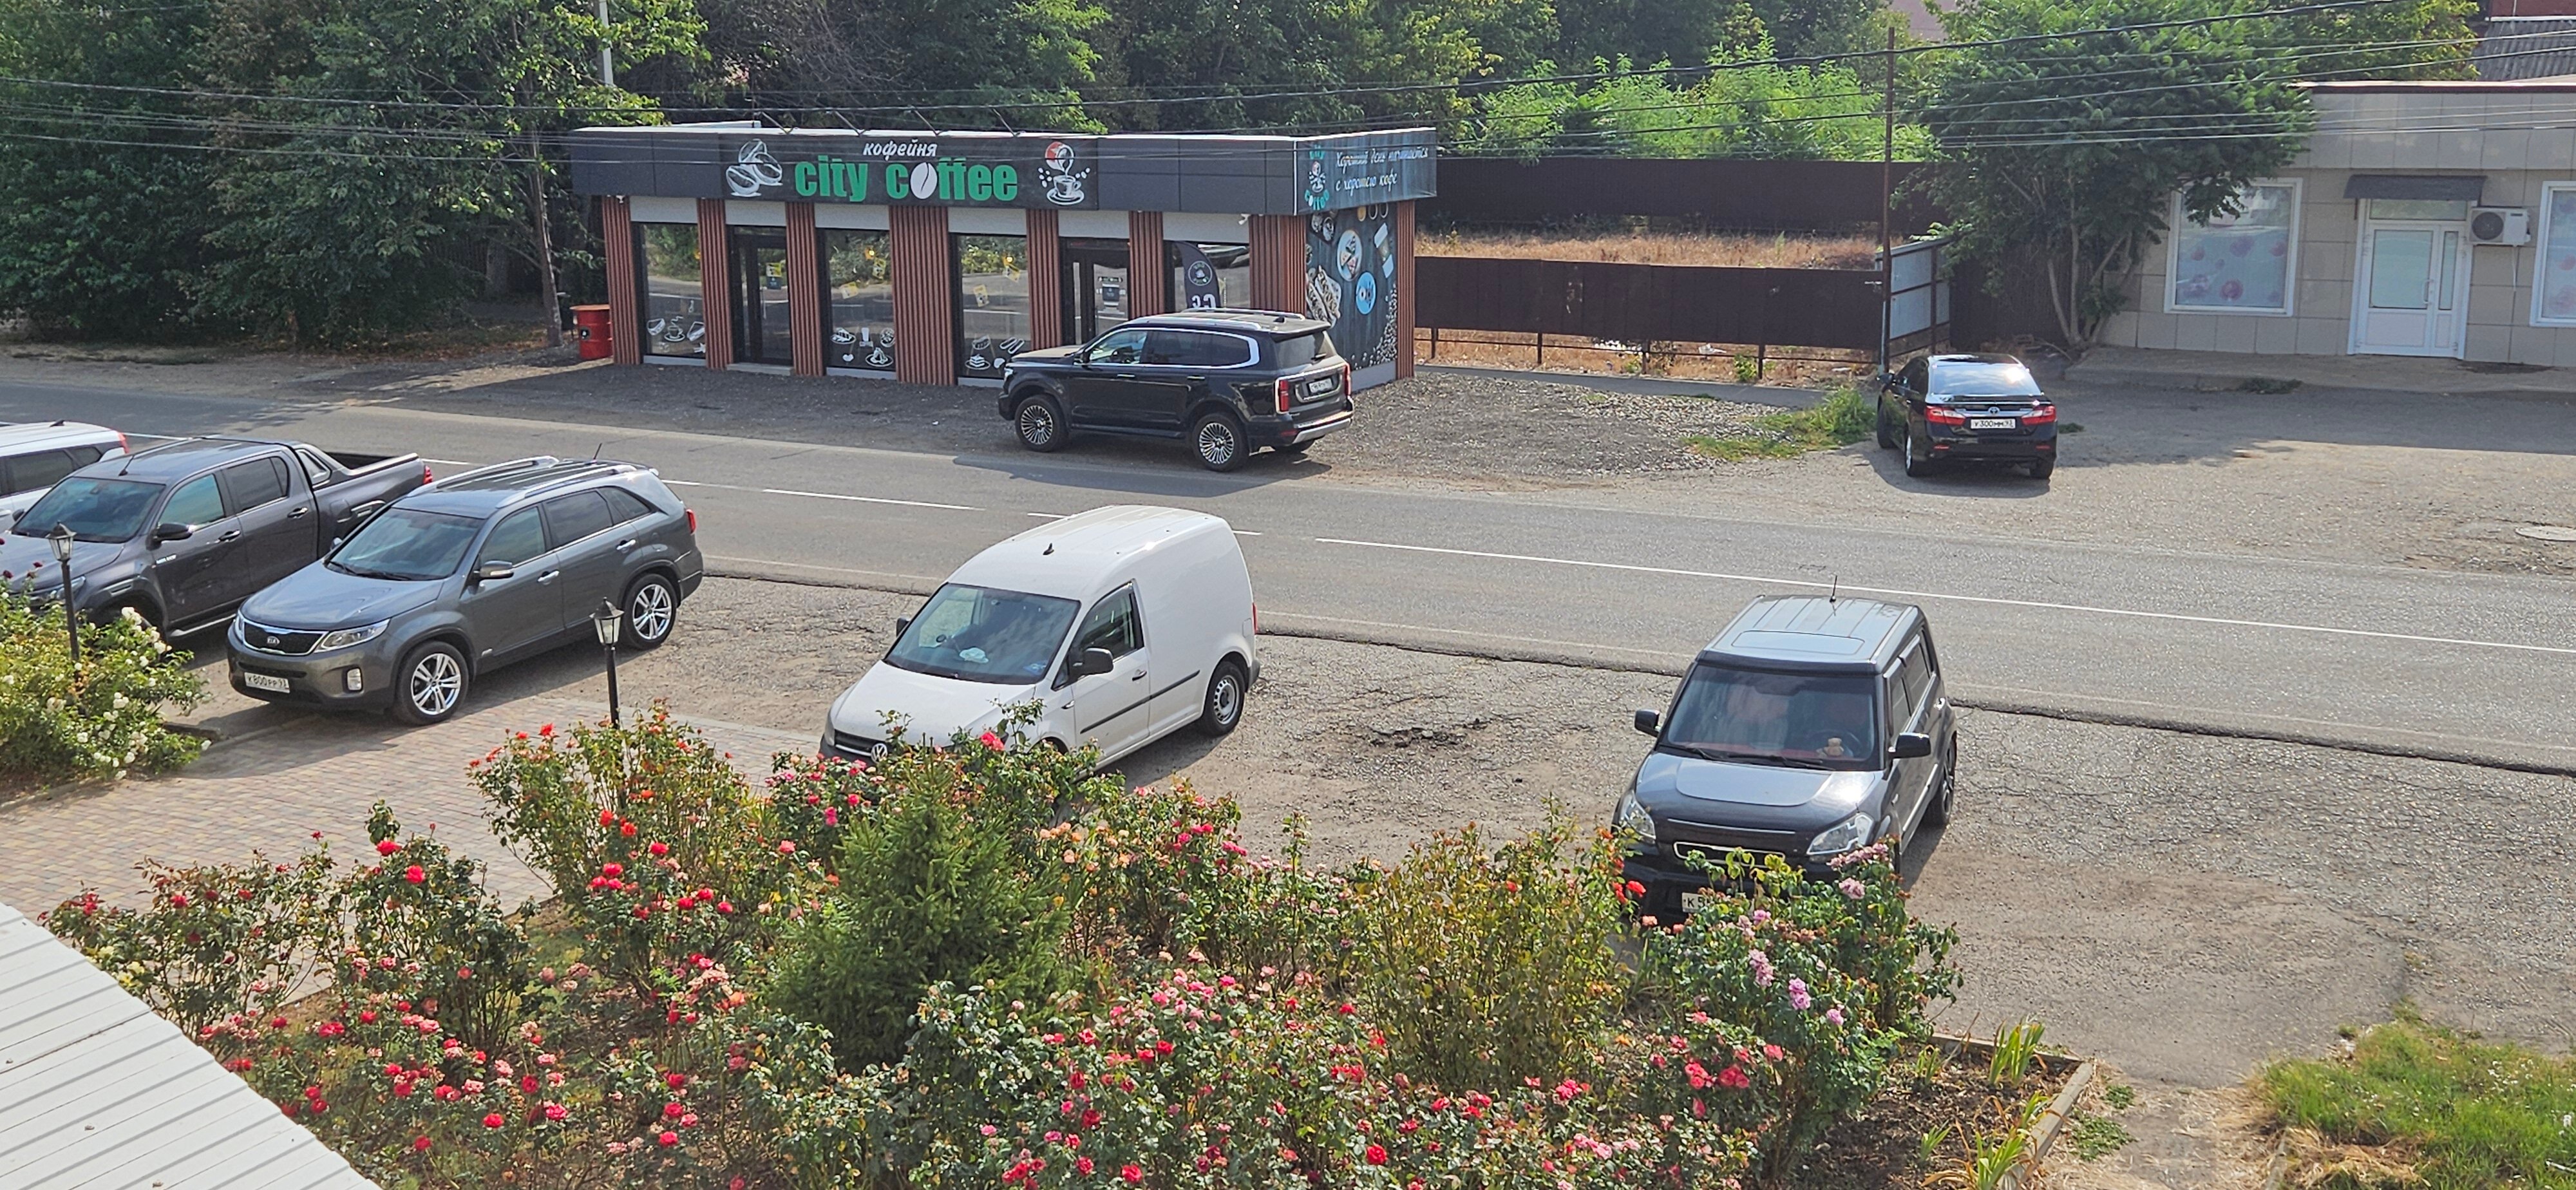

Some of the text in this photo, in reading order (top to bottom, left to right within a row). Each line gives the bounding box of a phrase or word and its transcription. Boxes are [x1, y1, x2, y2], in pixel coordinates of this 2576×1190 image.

[863, 138, 938, 161] кофейня
[795, 155, 1018, 202] city coffee
[1379, 167, 1397, 192] кофе
